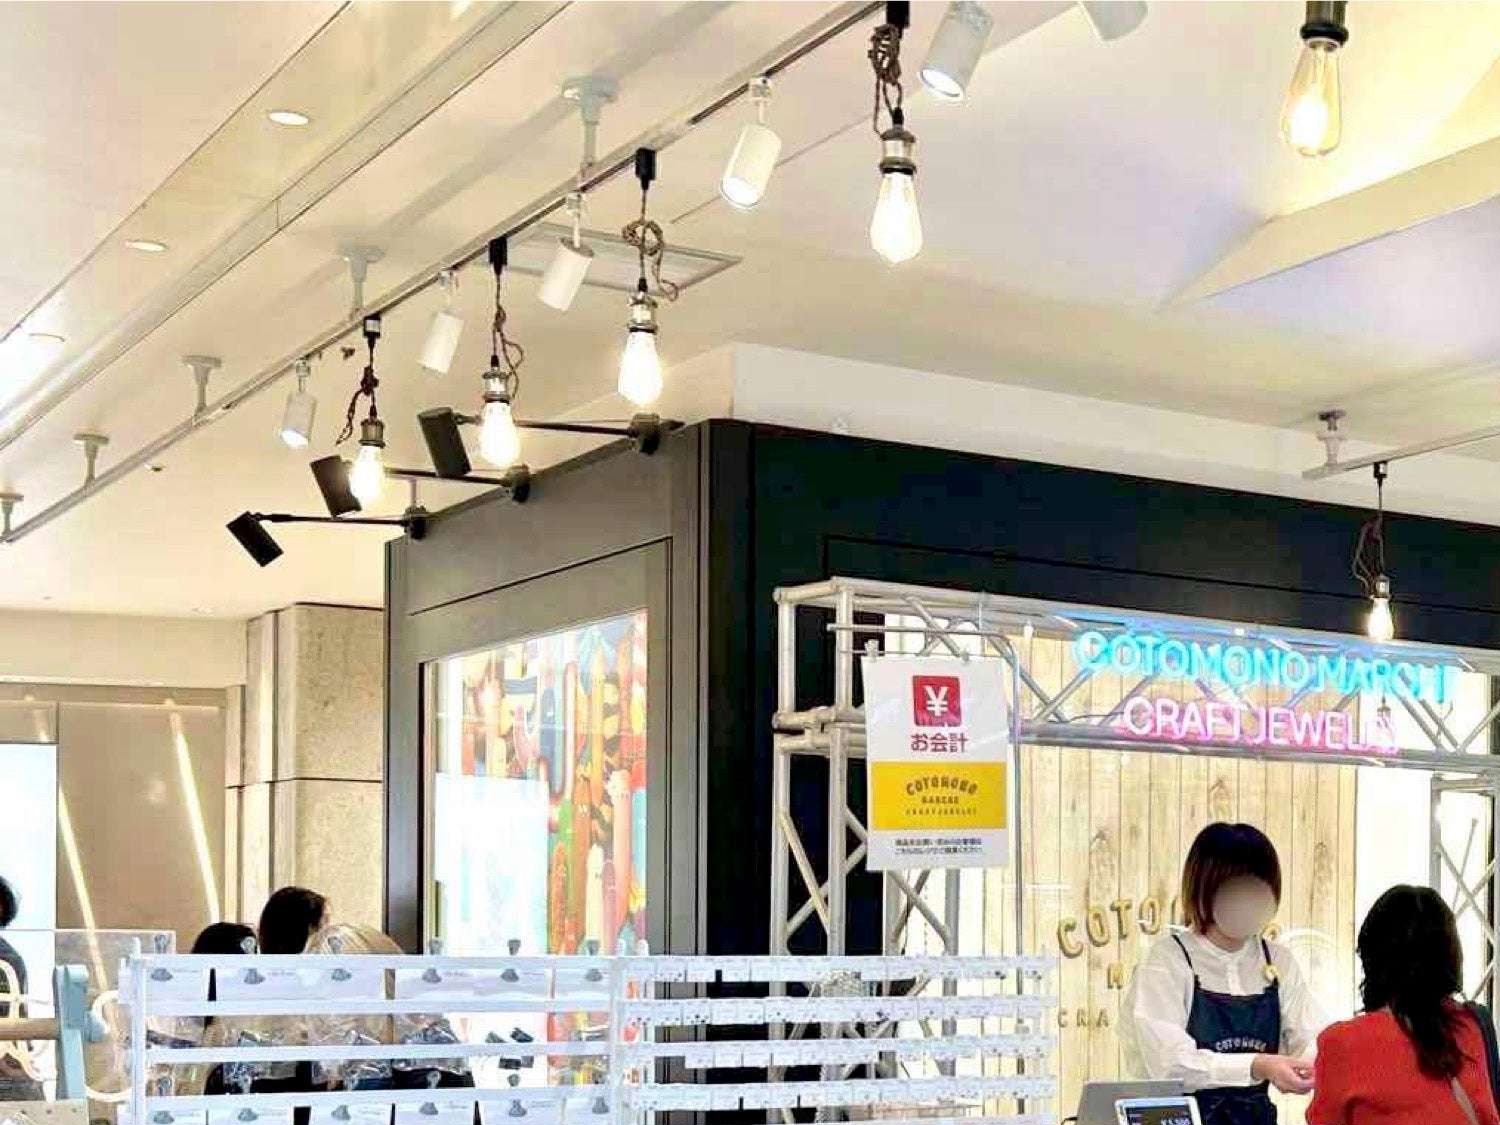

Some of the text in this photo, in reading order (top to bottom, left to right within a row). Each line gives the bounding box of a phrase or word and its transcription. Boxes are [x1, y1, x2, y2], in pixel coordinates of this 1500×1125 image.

[1075, 631, 1310, 690] COTOMONO
[911, 733, 969, 753] お会計
[1122, 697, 1399, 753] CRAFT JEWEL
